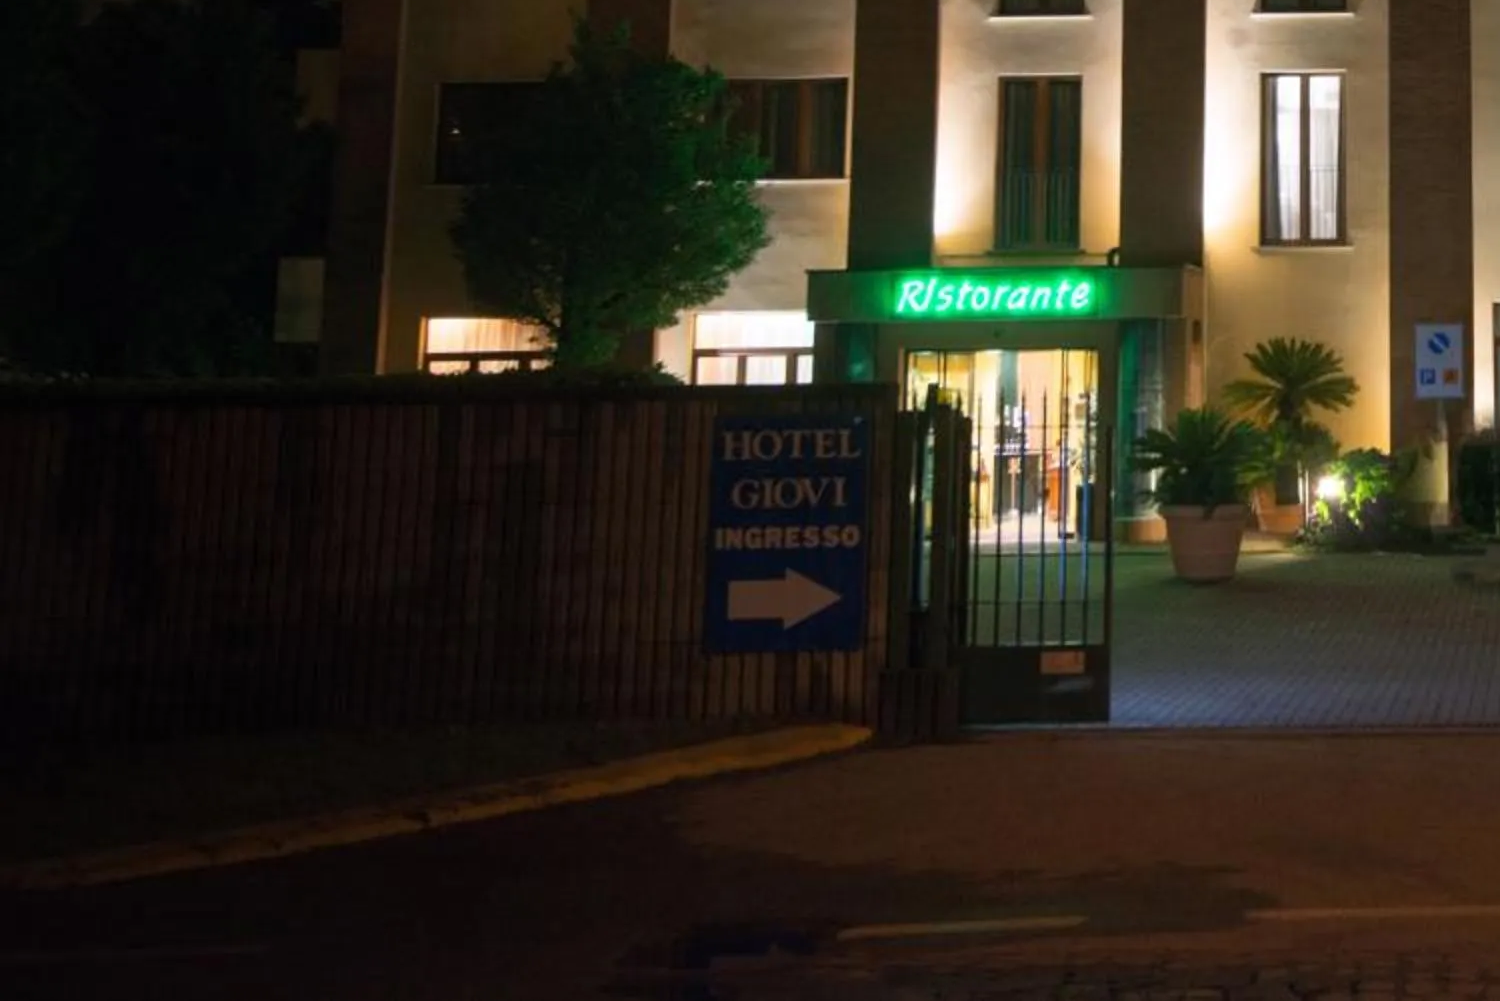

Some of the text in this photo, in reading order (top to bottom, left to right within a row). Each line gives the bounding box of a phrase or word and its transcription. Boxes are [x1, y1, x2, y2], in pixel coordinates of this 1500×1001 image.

[722, 428, 862, 461] HOTEL
[731, 476, 848, 510] GIOVI
[715, 525, 862, 549] INGRESSO
